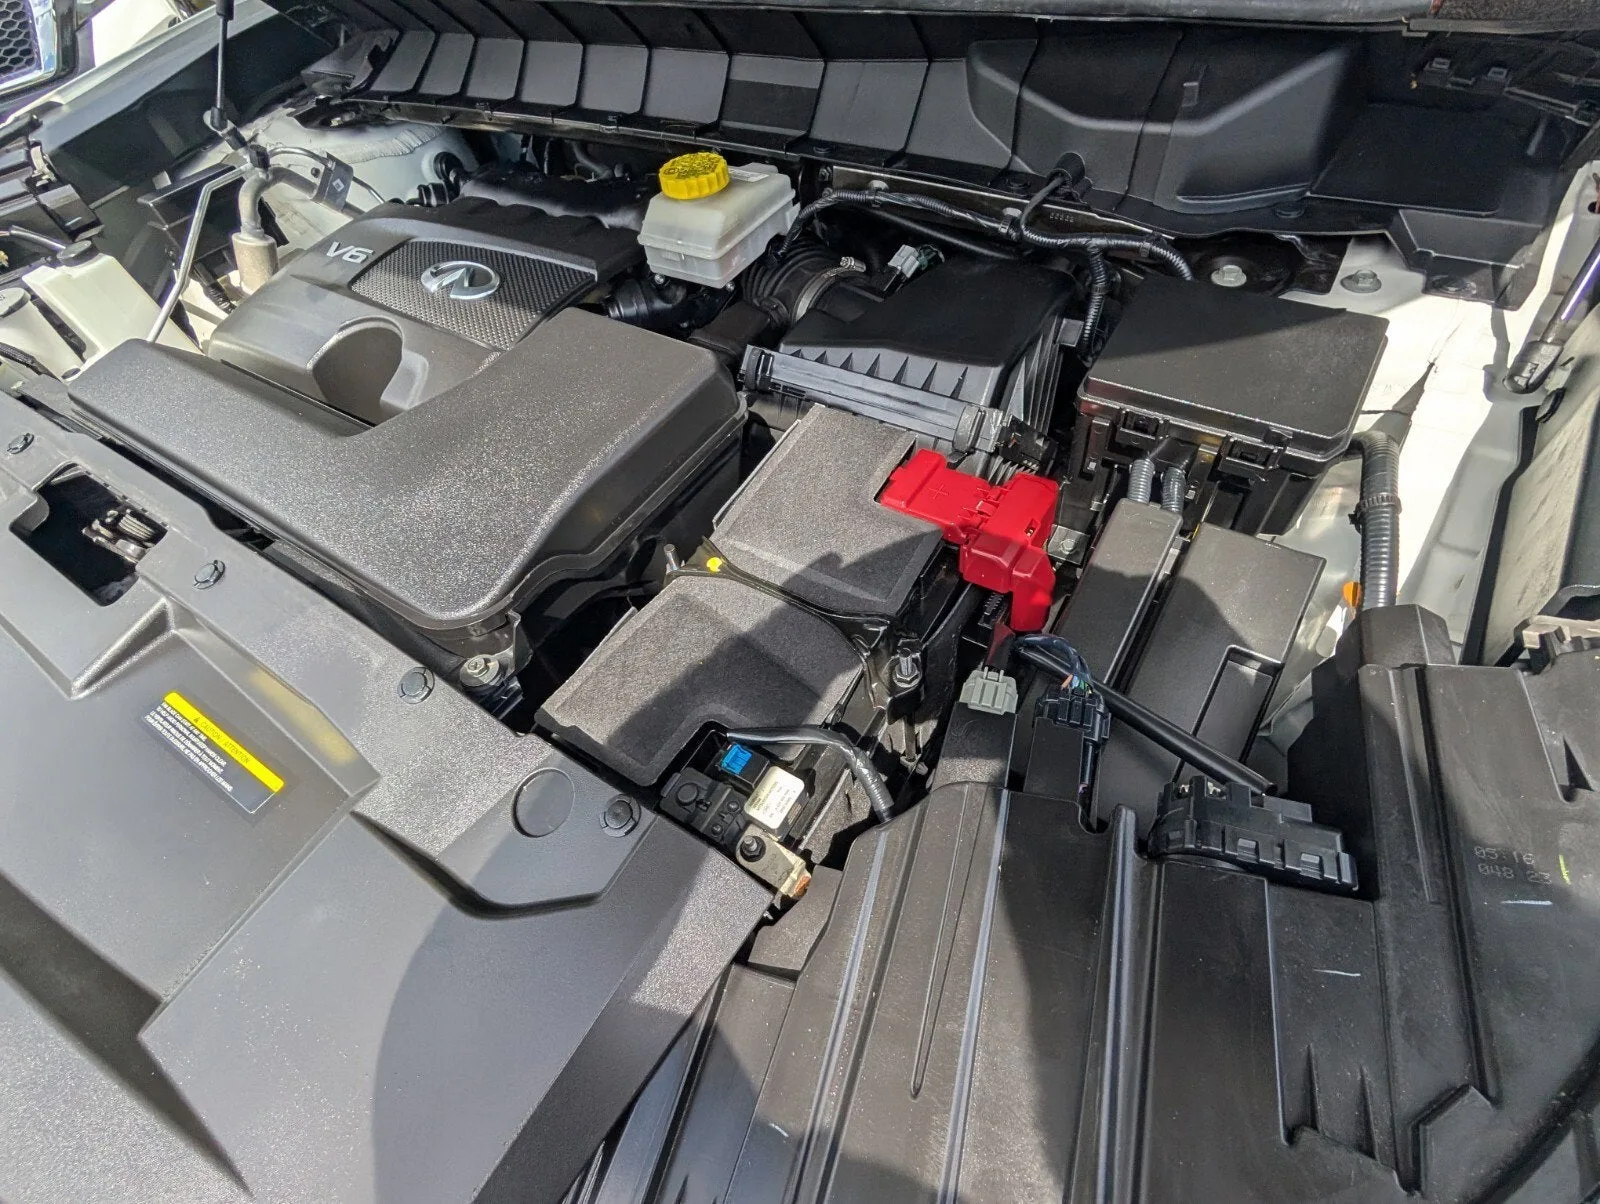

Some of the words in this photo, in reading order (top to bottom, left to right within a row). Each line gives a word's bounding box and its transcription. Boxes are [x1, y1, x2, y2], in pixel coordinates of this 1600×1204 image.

[326, 241, 375, 264] V6
[199, 720, 223, 742] CAUTION
[223, 739, 251, 765] ATTENTION
